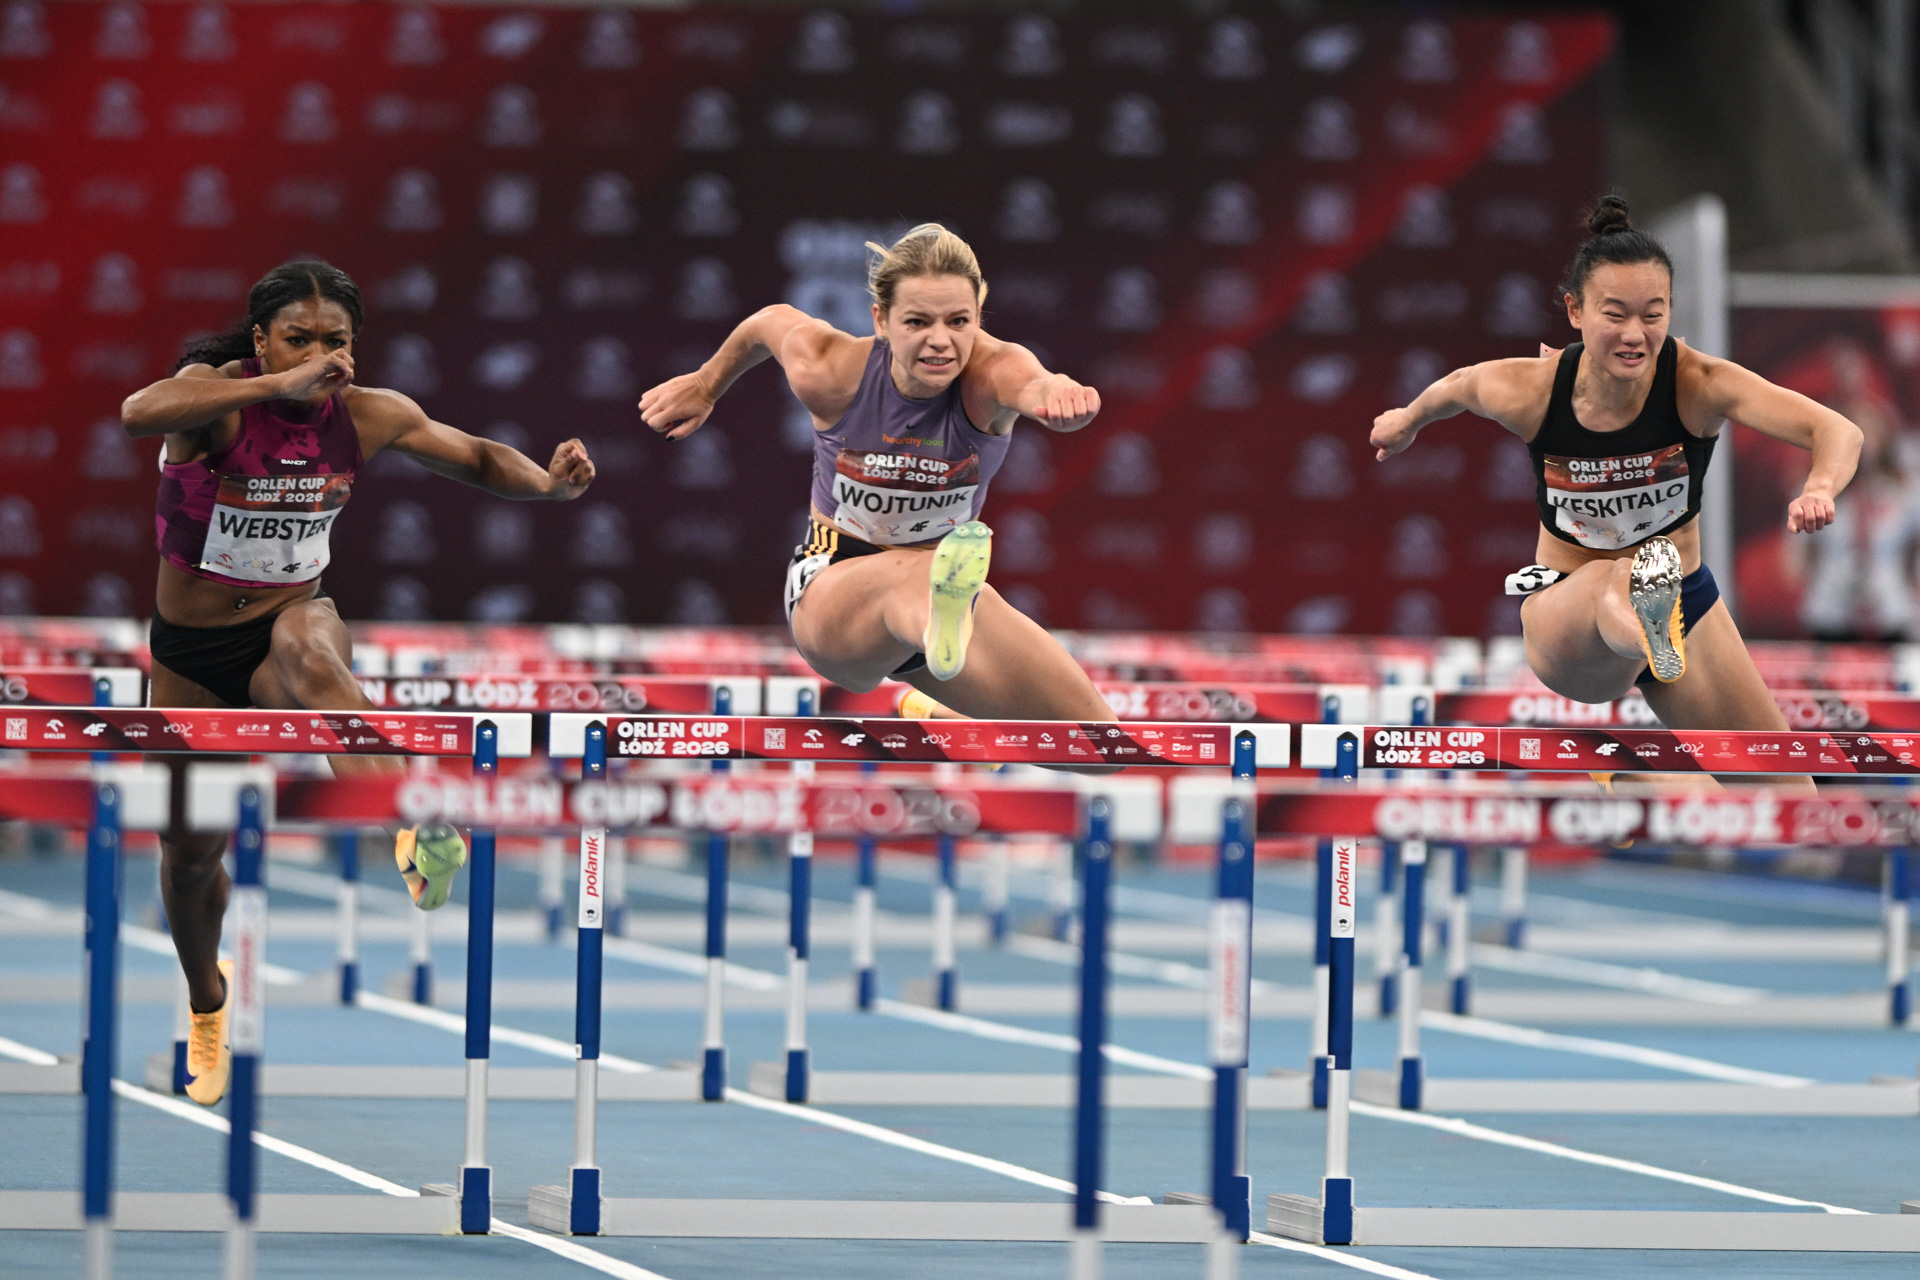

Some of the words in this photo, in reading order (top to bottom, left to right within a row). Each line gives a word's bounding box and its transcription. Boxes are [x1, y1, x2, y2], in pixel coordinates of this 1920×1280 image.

[281, 458, 307, 466] BANDIT
[864, 453, 917, 469] ORLEN
[918, 458, 950, 474] CUP
[1568, 460, 1621, 473] ORLEN
[1623, 455, 1654, 469] CUP
[248, 478, 296, 491] ORLEN
[299, 477, 326, 490] CUP
[863, 467, 901, 481] ŁÓDŹ
[905, 471, 949, 485] 2026
[1571, 472, 1608, 484] ŁÓDŹ
[1612, 468, 1655, 482] 2026
[246, 491, 281, 503] ŁÓDŹ
[285, 492, 324, 503] 2026
[839, 482, 970, 515] WOJTUNIK
[1553, 483, 1685, 519] KESKITALO
[219, 511, 332, 542] WEBSTER
[282, 562, 301, 573] 4F
[393, 680, 451, 706] CUP
[547, 682, 648, 711] 2026
[1156, 689, 1259, 721] 2026
[1510, 695, 1612, 724] ORLEN
[83, 723, 107, 736] 4F
[617, 721, 685, 738] ORLEN
[690, 721, 729, 738] CUP
[1374, 730, 1441, 747] ORLEN
[1447, 731, 1485, 747] CUP
[618, 737, 666, 755] ŁÓDŹ
[672, 741, 730, 755] 2026
[841, 733, 866, 746] 4F
[1375, 746, 1422, 764] ŁÓDŹ
[1428, 750, 1485, 764] 2026
[1595, 743, 1619, 756] 4F
[400, 780, 563, 824] ORLEN
[570, 782, 669, 829] CUP
[813, 785, 982, 837] 2026
[1373, 798, 1539, 842] ORLEN
[1548, 797, 1646, 844] CUP
[1793, 796, 1920, 848] 202
[584, 834, 599, 898] polanik
[1336, 846, 1352, 907] polanik
